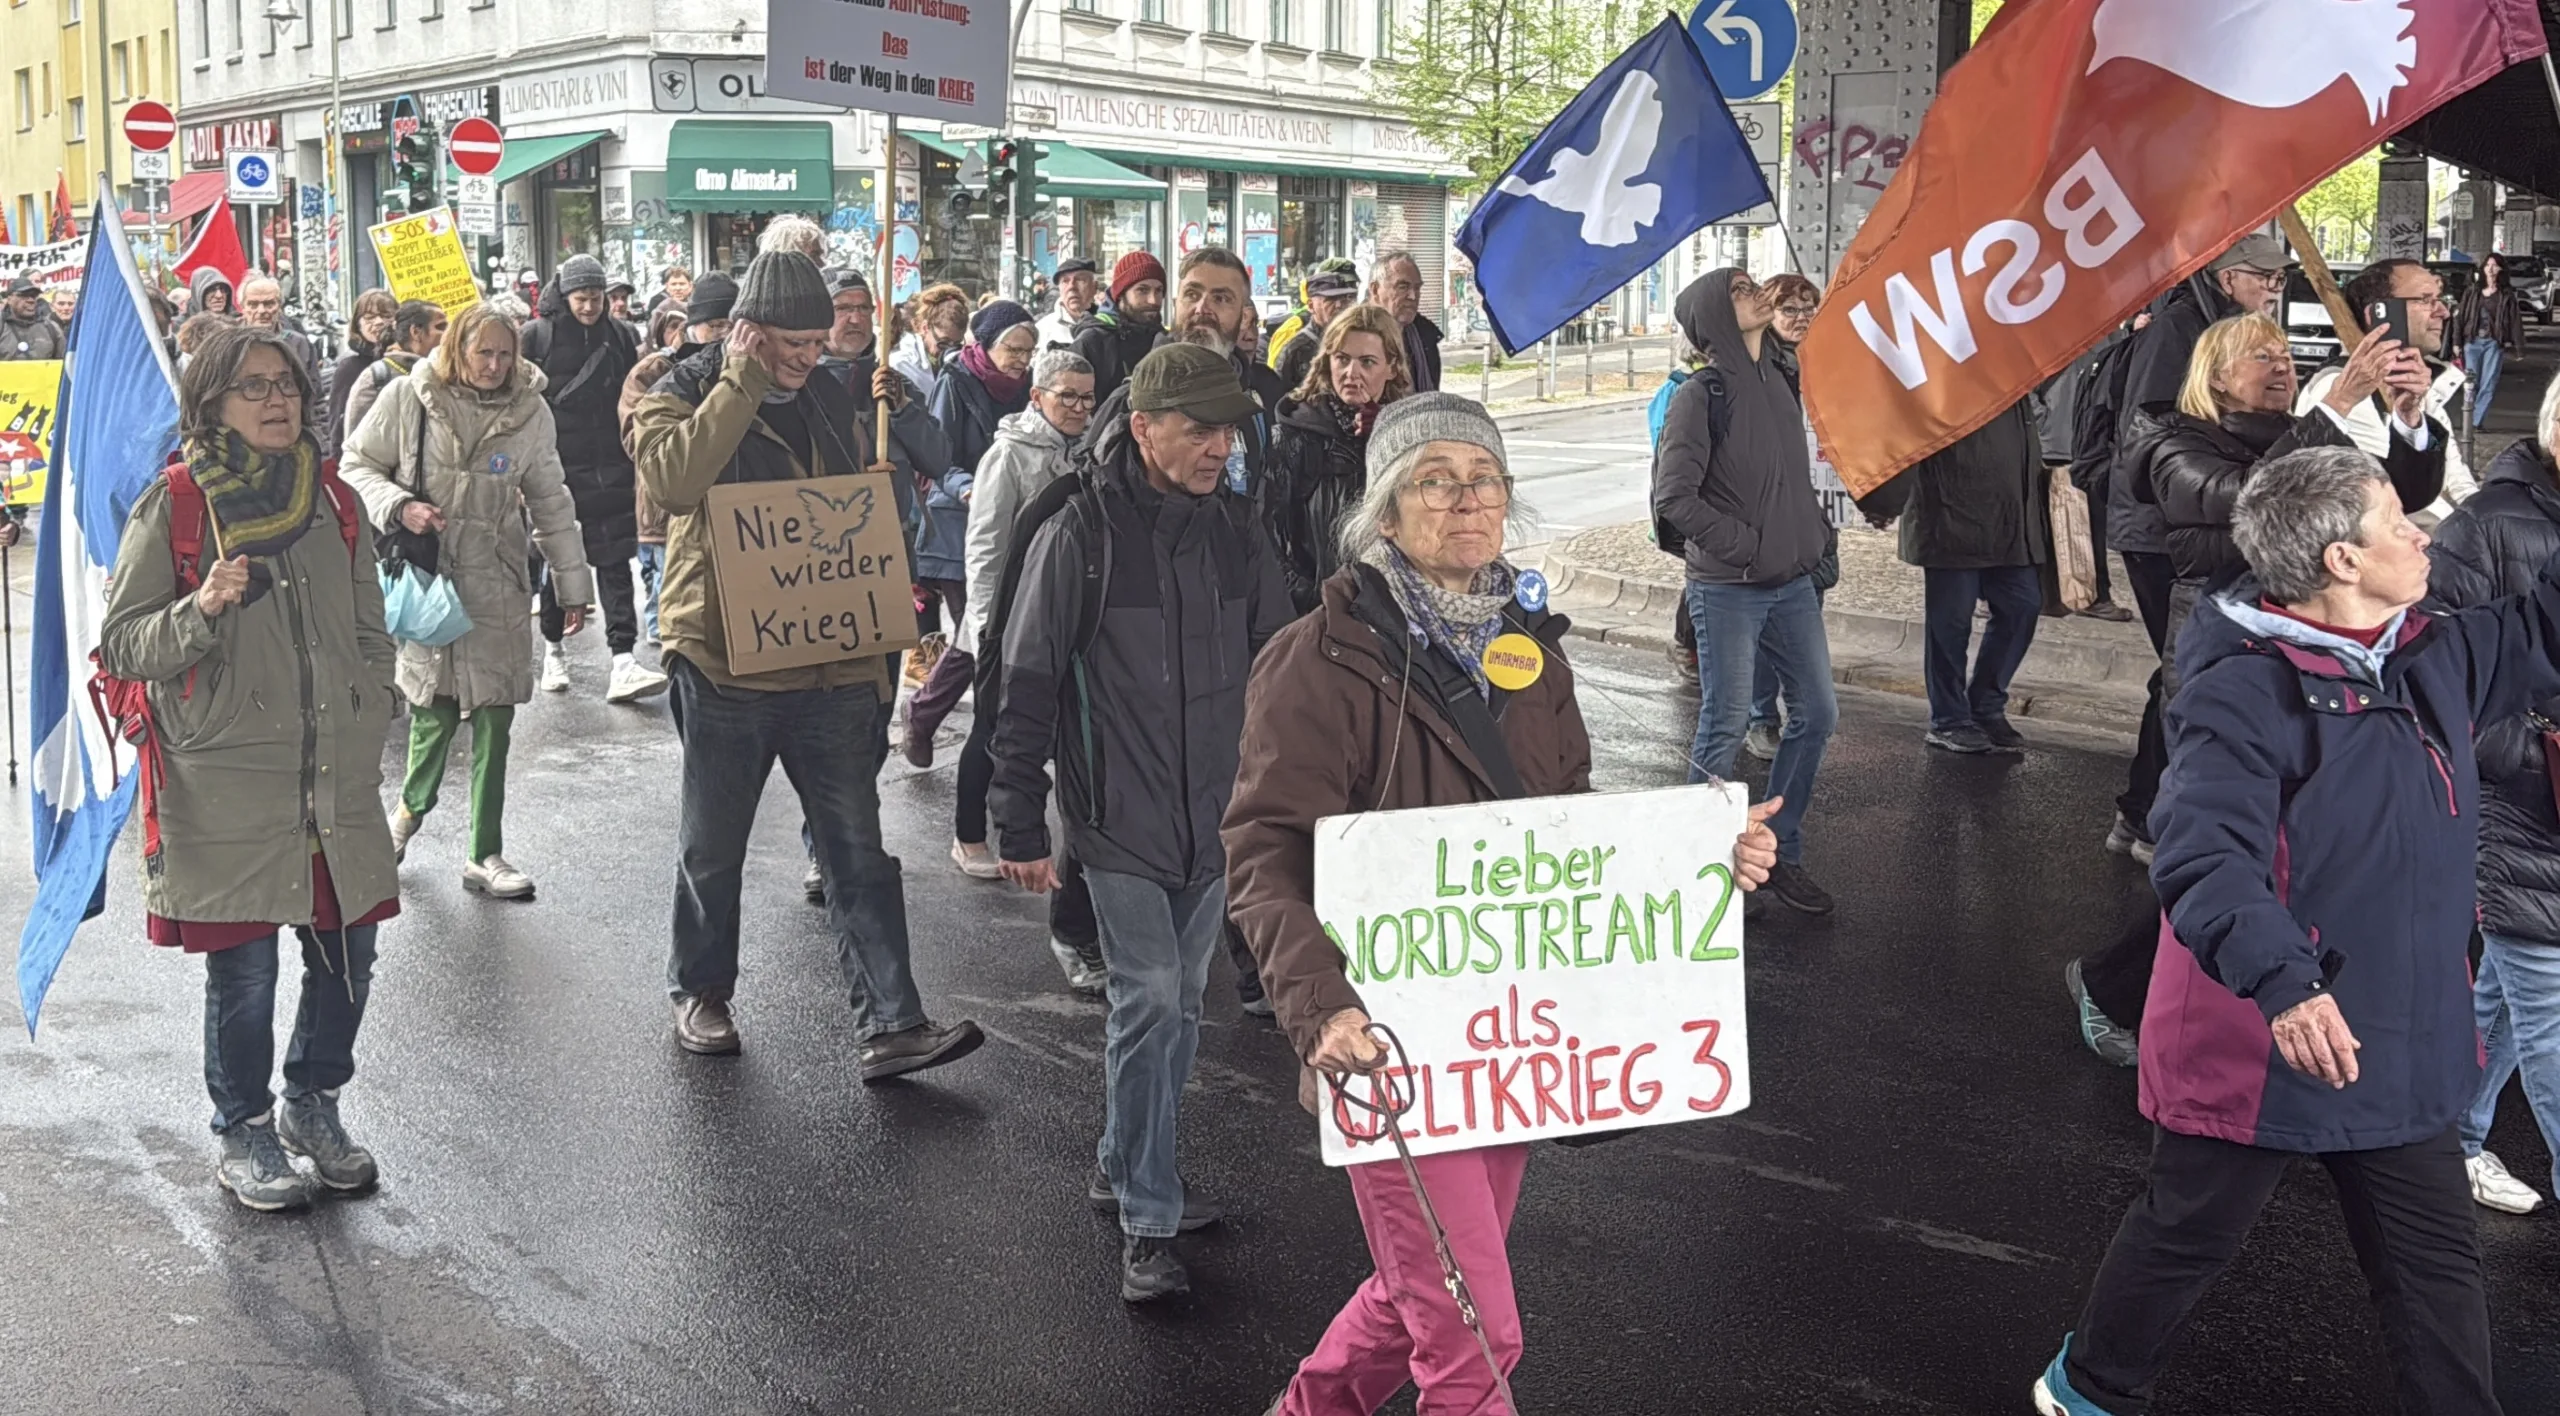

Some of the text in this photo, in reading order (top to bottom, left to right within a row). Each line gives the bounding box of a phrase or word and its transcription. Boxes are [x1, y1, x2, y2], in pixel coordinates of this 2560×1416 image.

[881, 31, 908, 56] Das
[503, 70, 628, 115] ALIMENTARI & VINI
[804, 56, 975, 102] ist der Weg in den KRIEG
[424, 87, 489, 123] FAHRSCHULE
[1060, 95, 1167, 130] ITALIENISCHE
[1173, 106, 1276, 140] SPEZIALITÄTEN
[1278, 121, 1289, 141] &
[1291, 120, 1333, 145] WEINE
[188, 119, 275, 162] ADIL KASAP
[1373, 127, 1409, 152] IMBISS
[695, 168, 797, 191] Olmo Alimentari
[386, 241, 420, 258] STOPPT
[394, 221, 425, 241] SOS
[733, 504, 802, 552] Nie
[770, 538, 893, 589] wieder
[751, 591, 882, 653] Krieg!
[1487, 649, 1537, 672] UMARMBAR
[1435, 829, 1616, 898] Lieber
[1323, 863, 1739, 985] NORDSTREAM 2
[1466, 984, 1561, 1051] als
[1681, 1019, 1733, 1113] 3
